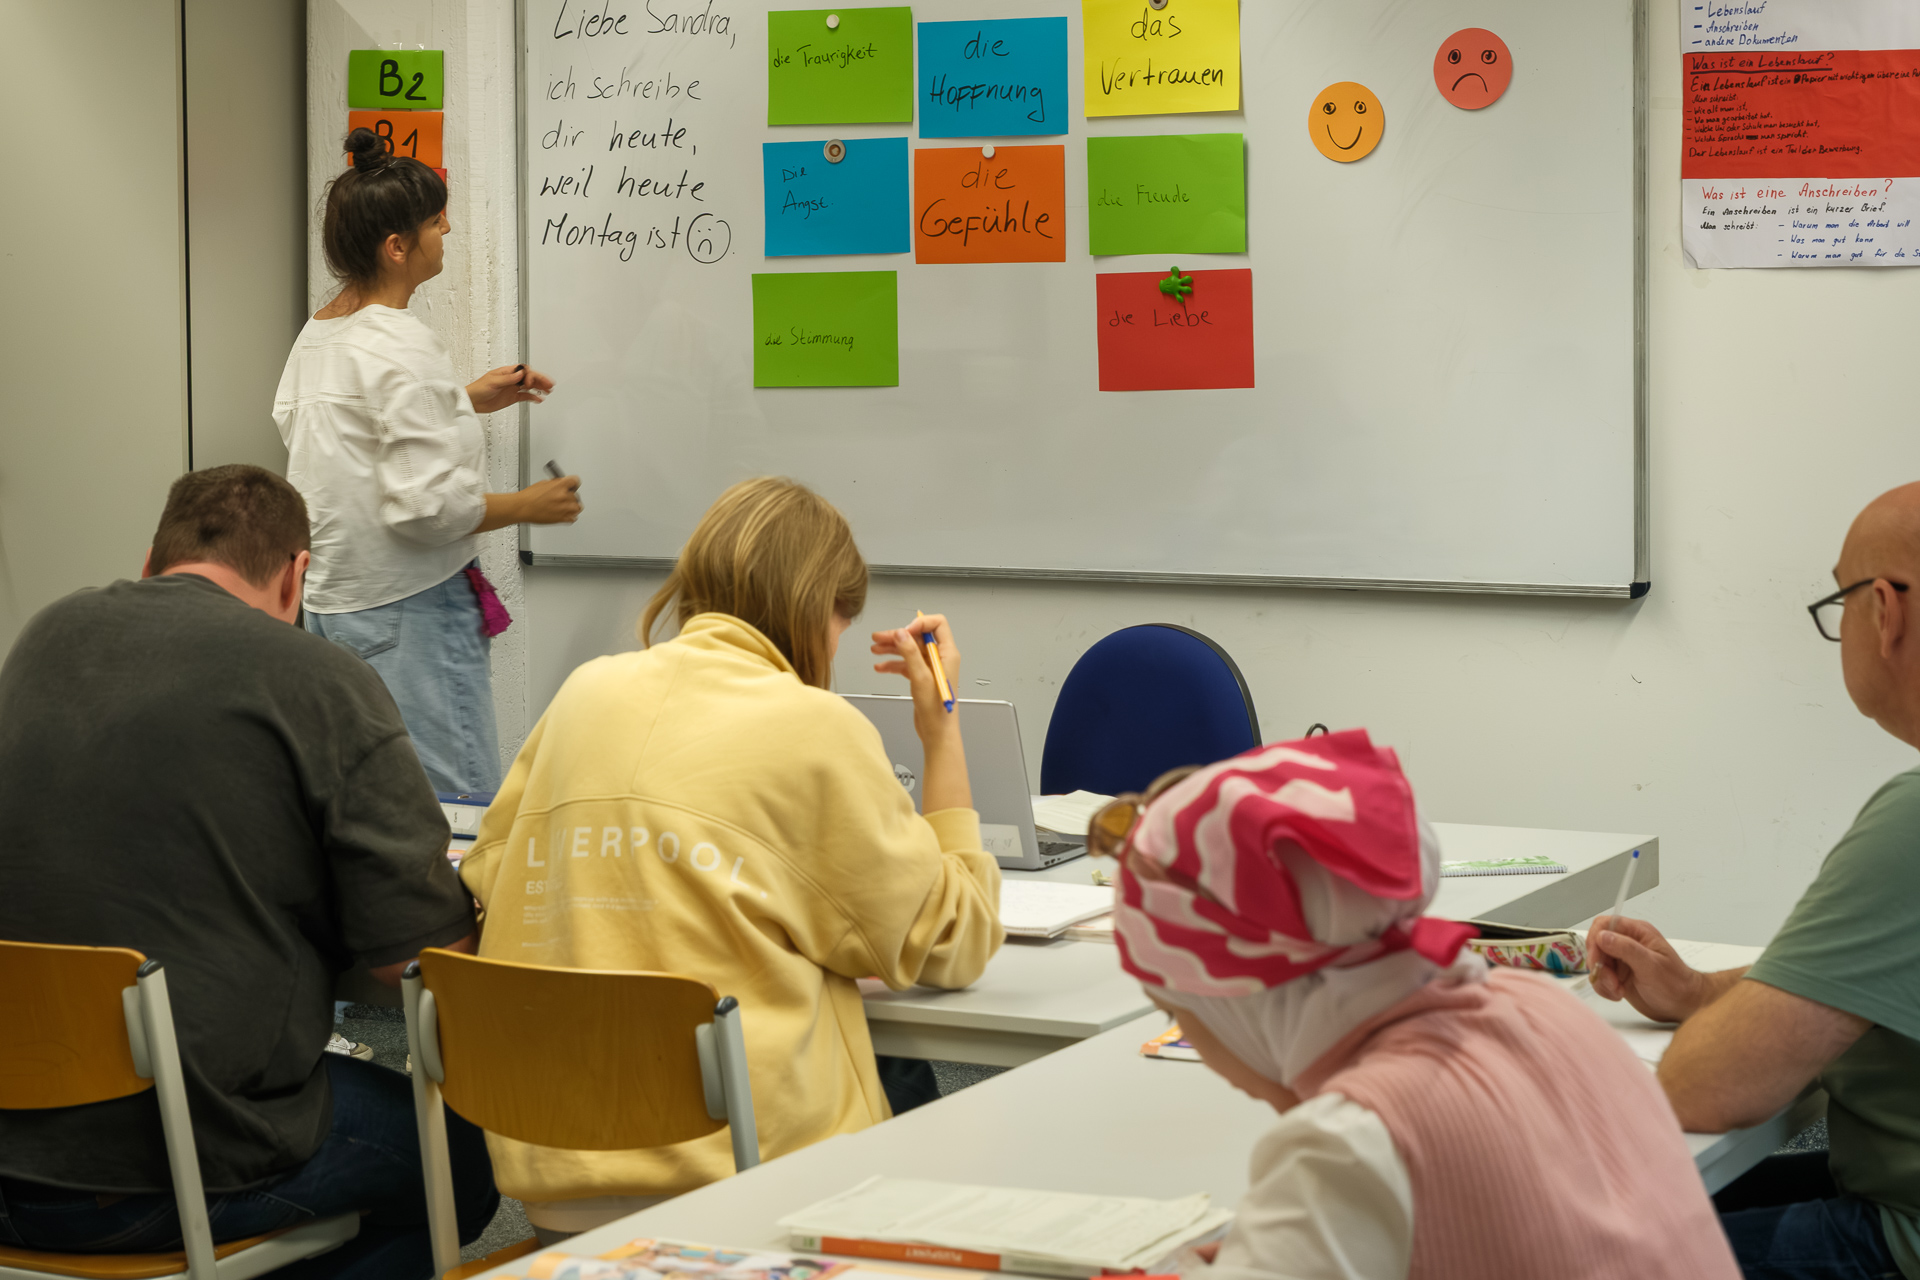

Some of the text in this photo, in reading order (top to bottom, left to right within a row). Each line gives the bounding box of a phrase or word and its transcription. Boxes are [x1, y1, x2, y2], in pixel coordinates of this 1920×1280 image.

[1708, 1, 1767, 18] Lebenslauf
[554, 0, 736, 49] Liebe Sandra,
[1131, 8, 1182, 41] das
[1706, 20, 1759, 33] Anschreiben
[964, 31, 1011, 60] die
[1705, 36, 1734, 46] andere
[773, 43, 878, 69] die Traurigkeit
[1692, 55, 1715, 70] Was
[1720, 56, 1735, 68] ist
[1739, 59, 1753, 67] ein
[379, 58, 427, 101] B2
[546, 65, 702, 101] ich schreibe
[1101, 57, 1223, 95] Vertrauen
[1691, 76, 1710, 92] Ein
[541, 117, 696, 155] dir heute,
[1689, 147, 1707, 157] Der
[1709, 145, 1755, 157] Lebenslauf
[1757, 145, 1768, 154] ist
[540, 164, 705, 202] weil heute
[782, 166, 807, 183] Die
[961, 161, 1016, 189] die
[1097, 184, 1190, 207] die Freude
[1702, 186, 1724, 200] Was
[1730, 186, 1747, 200] ist
[1757, 185, 1787, 200] eine
[1798, 182, 1878, 198] Anschreiben
[1702, 206, 1715, 216] Ein
[1722, 205, 1777, 216] Anschreiben
[1788, 205, 1799, 215] ist
[1806, 206, 1818, 215] ein
[1825, 202, 1854, 214] kurzer
[920, 198, 1053, 247] Gefühle
[1700, 221, 1717, 230] Man
[1792, 220, 1818, 229] Warum
[1848, 219, 1860, 228] die
[1897, 219, 1911, 228] will
[542, 212, 681, 262] Montag ist
[1791, 234, 1805, 244] Was
[1832, 236, 1846, 247] gut
[1855, 233, 1874, 243] kann
[1791, 251, 1817, 259] Warum
[1849, 250, 1863, 262] gut
[1874, 248, 1888, 258] für
[1894, 247, 1905, 258] die
[1109, 305, 1213, 327] die Liebe
[765, 326, 854, 352] die Stimmung
